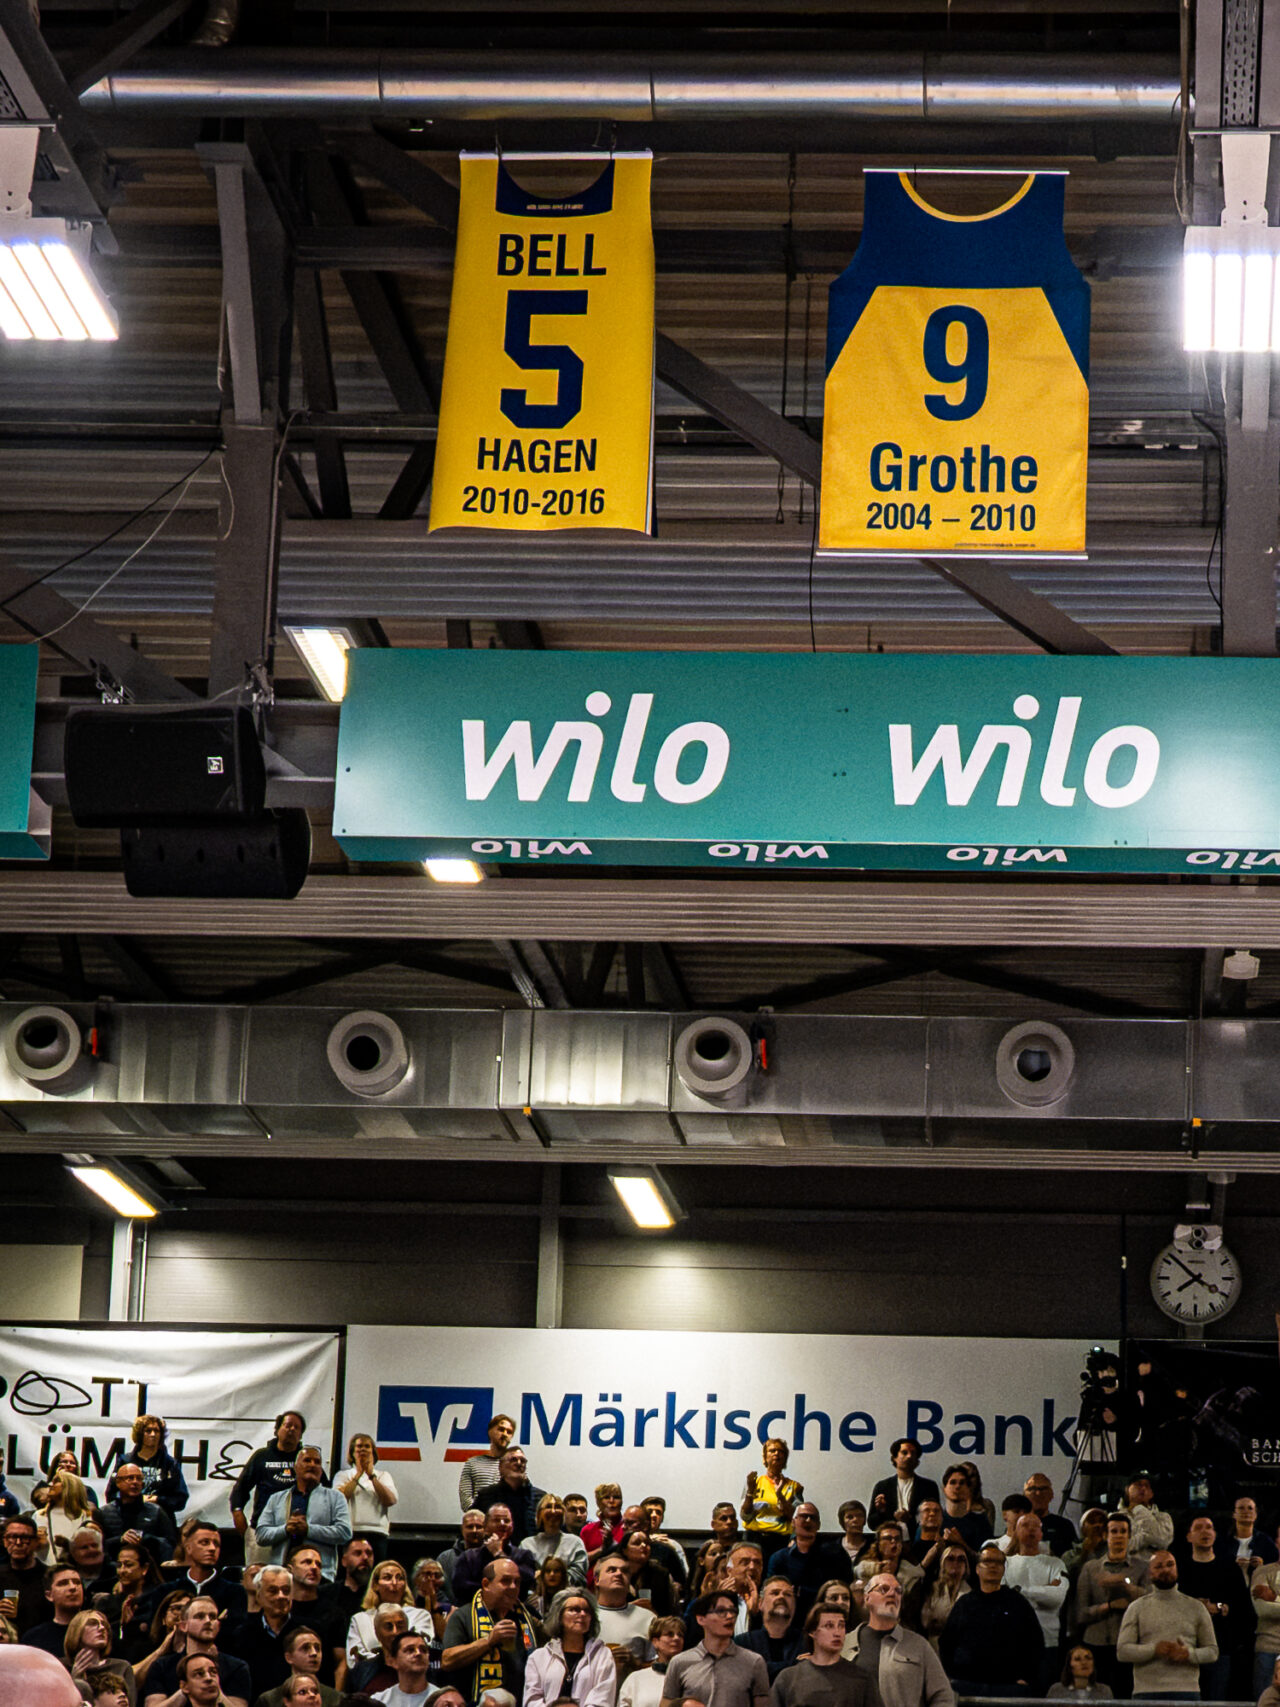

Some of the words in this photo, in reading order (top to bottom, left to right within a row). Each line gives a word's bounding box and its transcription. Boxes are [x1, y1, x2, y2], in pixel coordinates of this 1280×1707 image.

[497, 233, 607, 276] BELL
[499, 289, 589, 429] 5
[923, 304, 989, 422] 9
[477, 437, 597, 473] HAGEN
[870, 442, 1038, 493] Grothe
[462, 485, 605, 516] 2010-2016
[866, 502, 932, 530] 2004
[970, 503, 1036, 532] 2010
[461, 690, 730, 804] wilo
[888, 694, 1160, 808] wilo
[471, 840, 592, 858] wilo
[708, 843, 829, 862] wilo
[946, 847, 1068, 866] wilo
[519, 1391, 877, 1453] Märkische
[906, 1398, 1078, 1458] Bank
